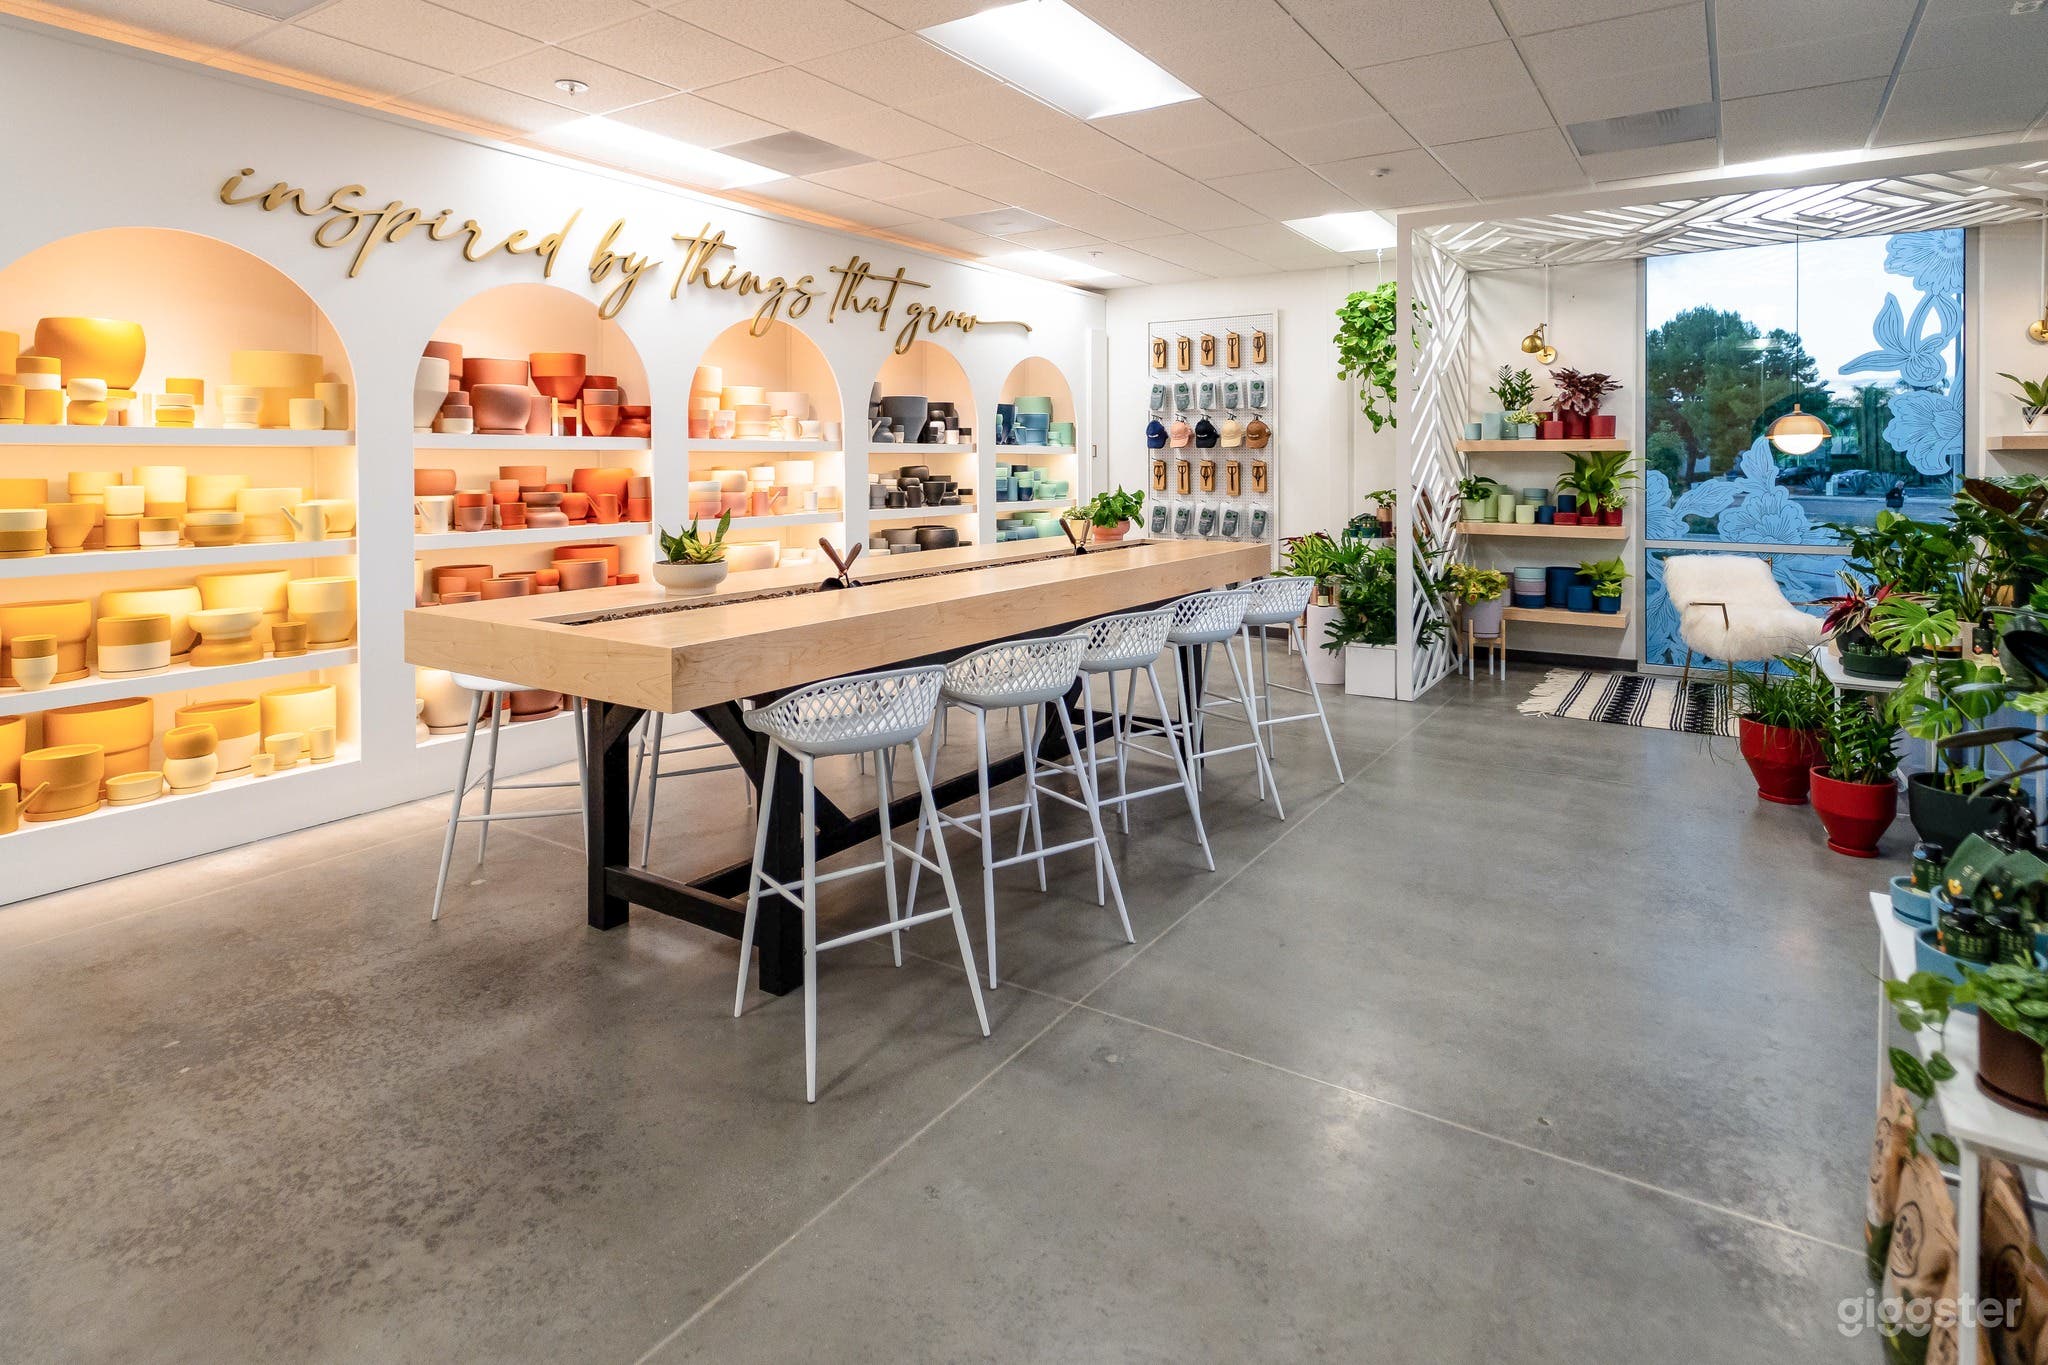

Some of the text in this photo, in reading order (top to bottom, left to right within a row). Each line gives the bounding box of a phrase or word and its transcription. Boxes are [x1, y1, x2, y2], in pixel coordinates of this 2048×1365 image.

[218, 166, 1033, 355] inspired by things that grow
